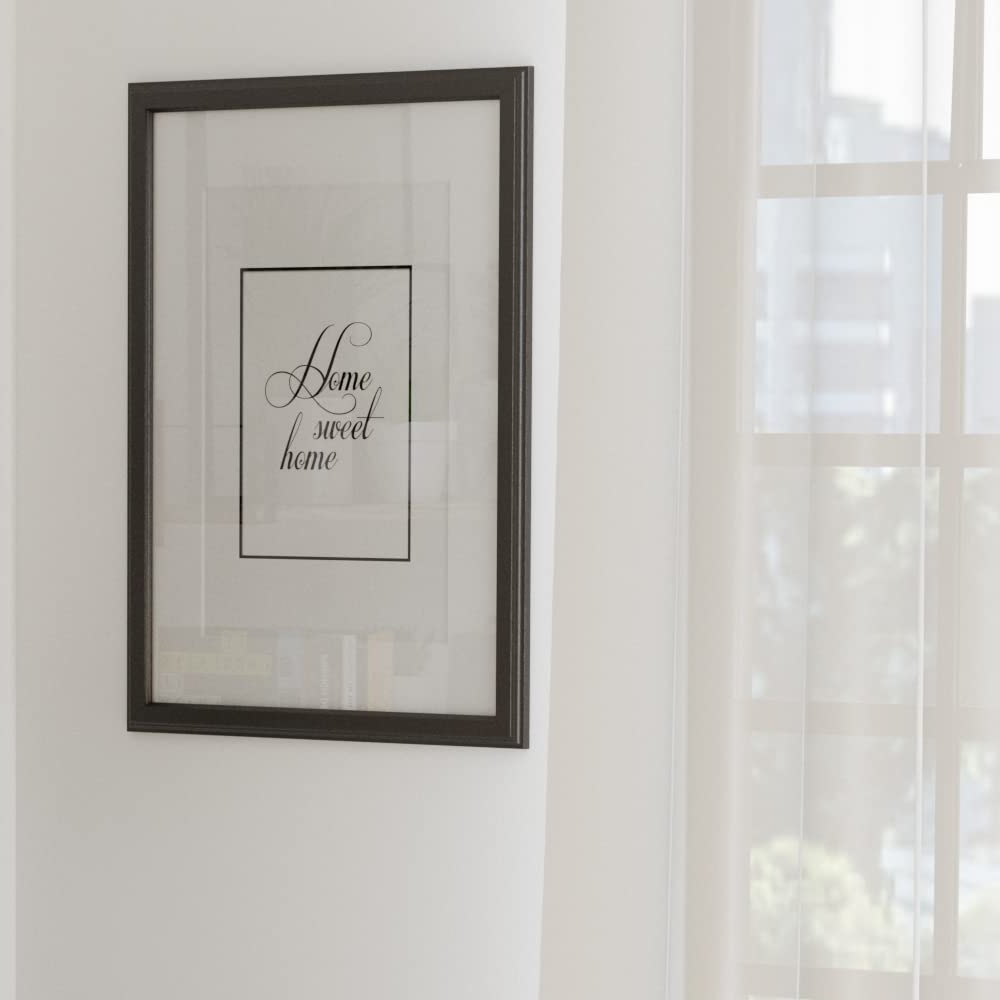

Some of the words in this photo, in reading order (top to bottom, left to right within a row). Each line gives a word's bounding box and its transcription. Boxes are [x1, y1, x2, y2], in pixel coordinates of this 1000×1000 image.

[265, 322, 373, 415] Home
[280, 411, 338, 470] home
[312, 386, 384, 440] sweet
